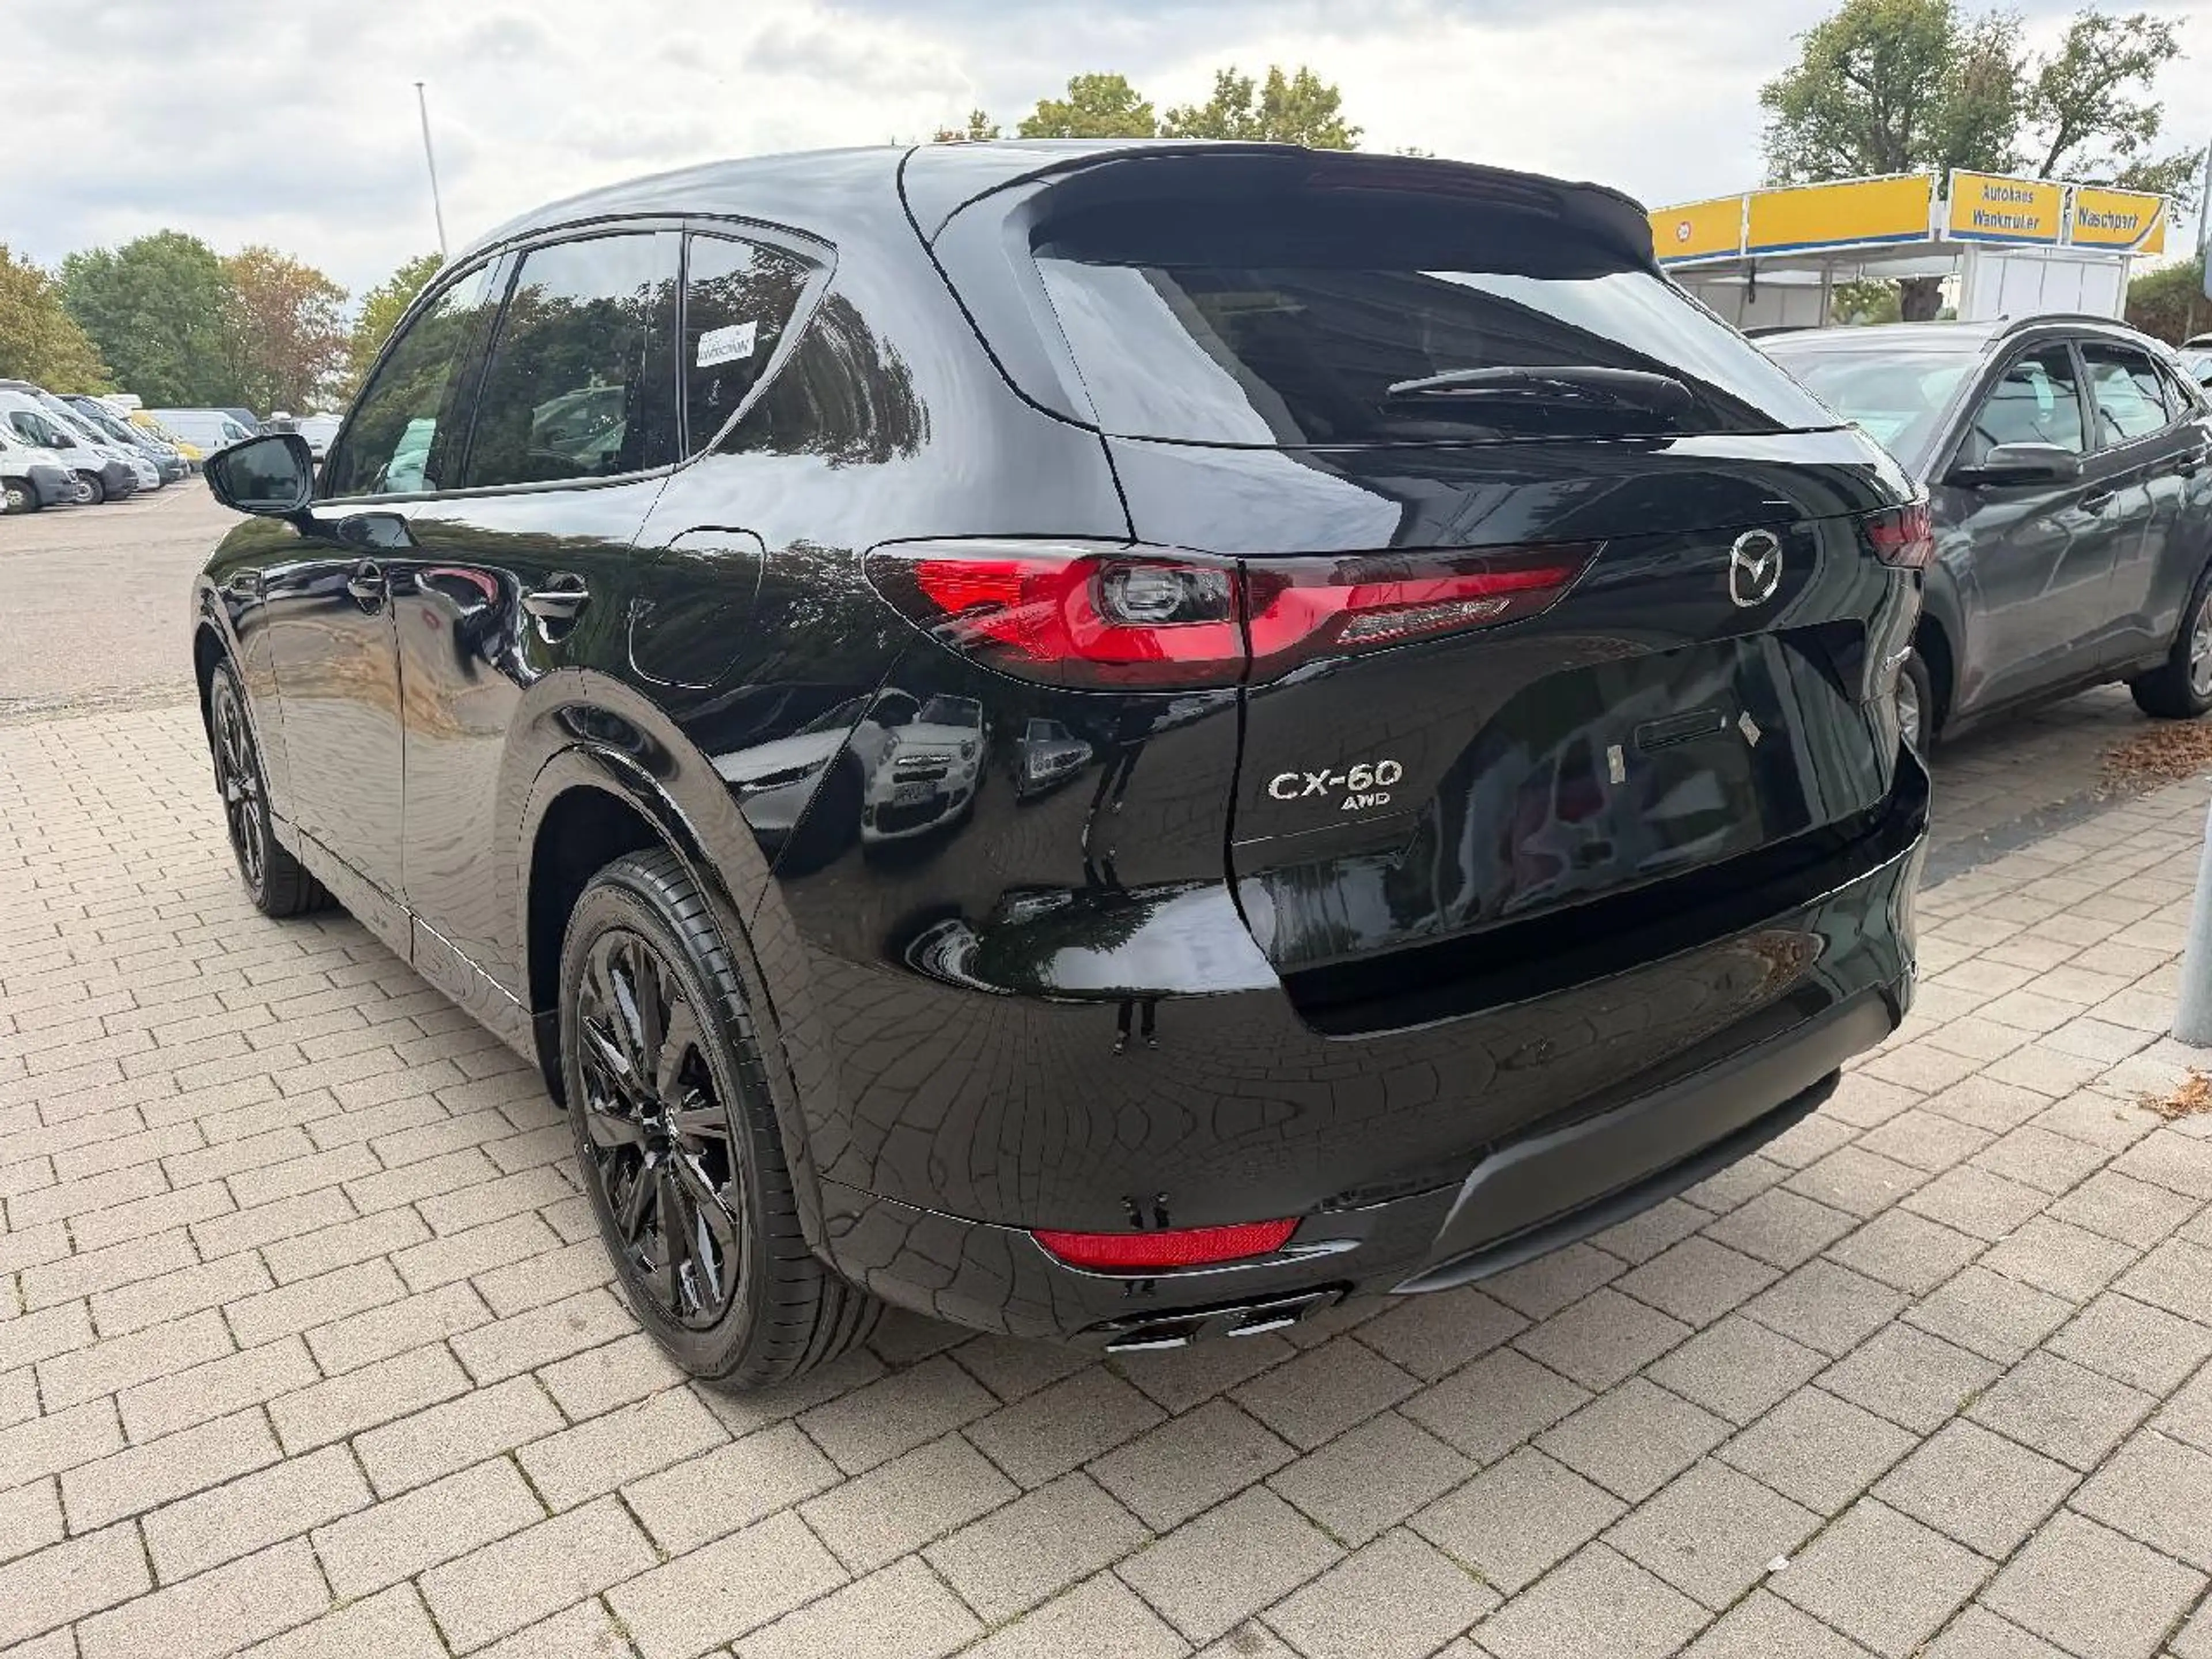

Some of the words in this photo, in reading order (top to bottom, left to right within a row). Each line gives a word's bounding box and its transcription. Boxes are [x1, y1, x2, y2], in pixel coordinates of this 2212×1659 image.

[1983, 184, 2034, 204] Autohaus
[1268, 760, 1403, 800] CX-60
[1341, 791, 1391, 810] AWD
